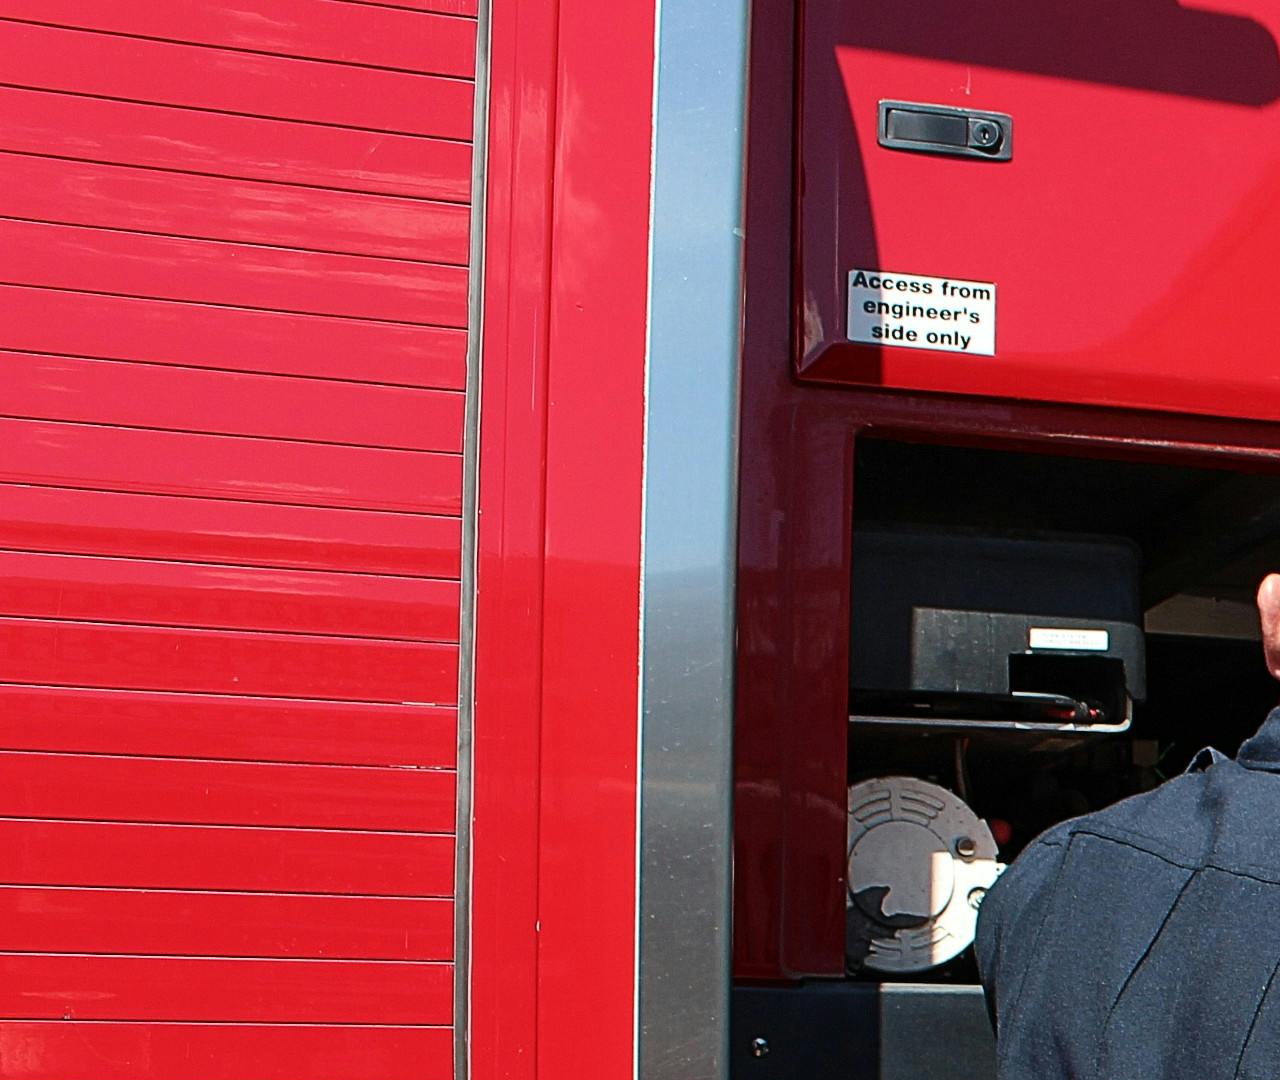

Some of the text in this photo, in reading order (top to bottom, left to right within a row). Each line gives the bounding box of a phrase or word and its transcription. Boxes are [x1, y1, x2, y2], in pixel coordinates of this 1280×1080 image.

[853, 271, 991, 301] Access from
[863, 299, 980, 324] engineer's
[871, 324, 971, 350] side only
